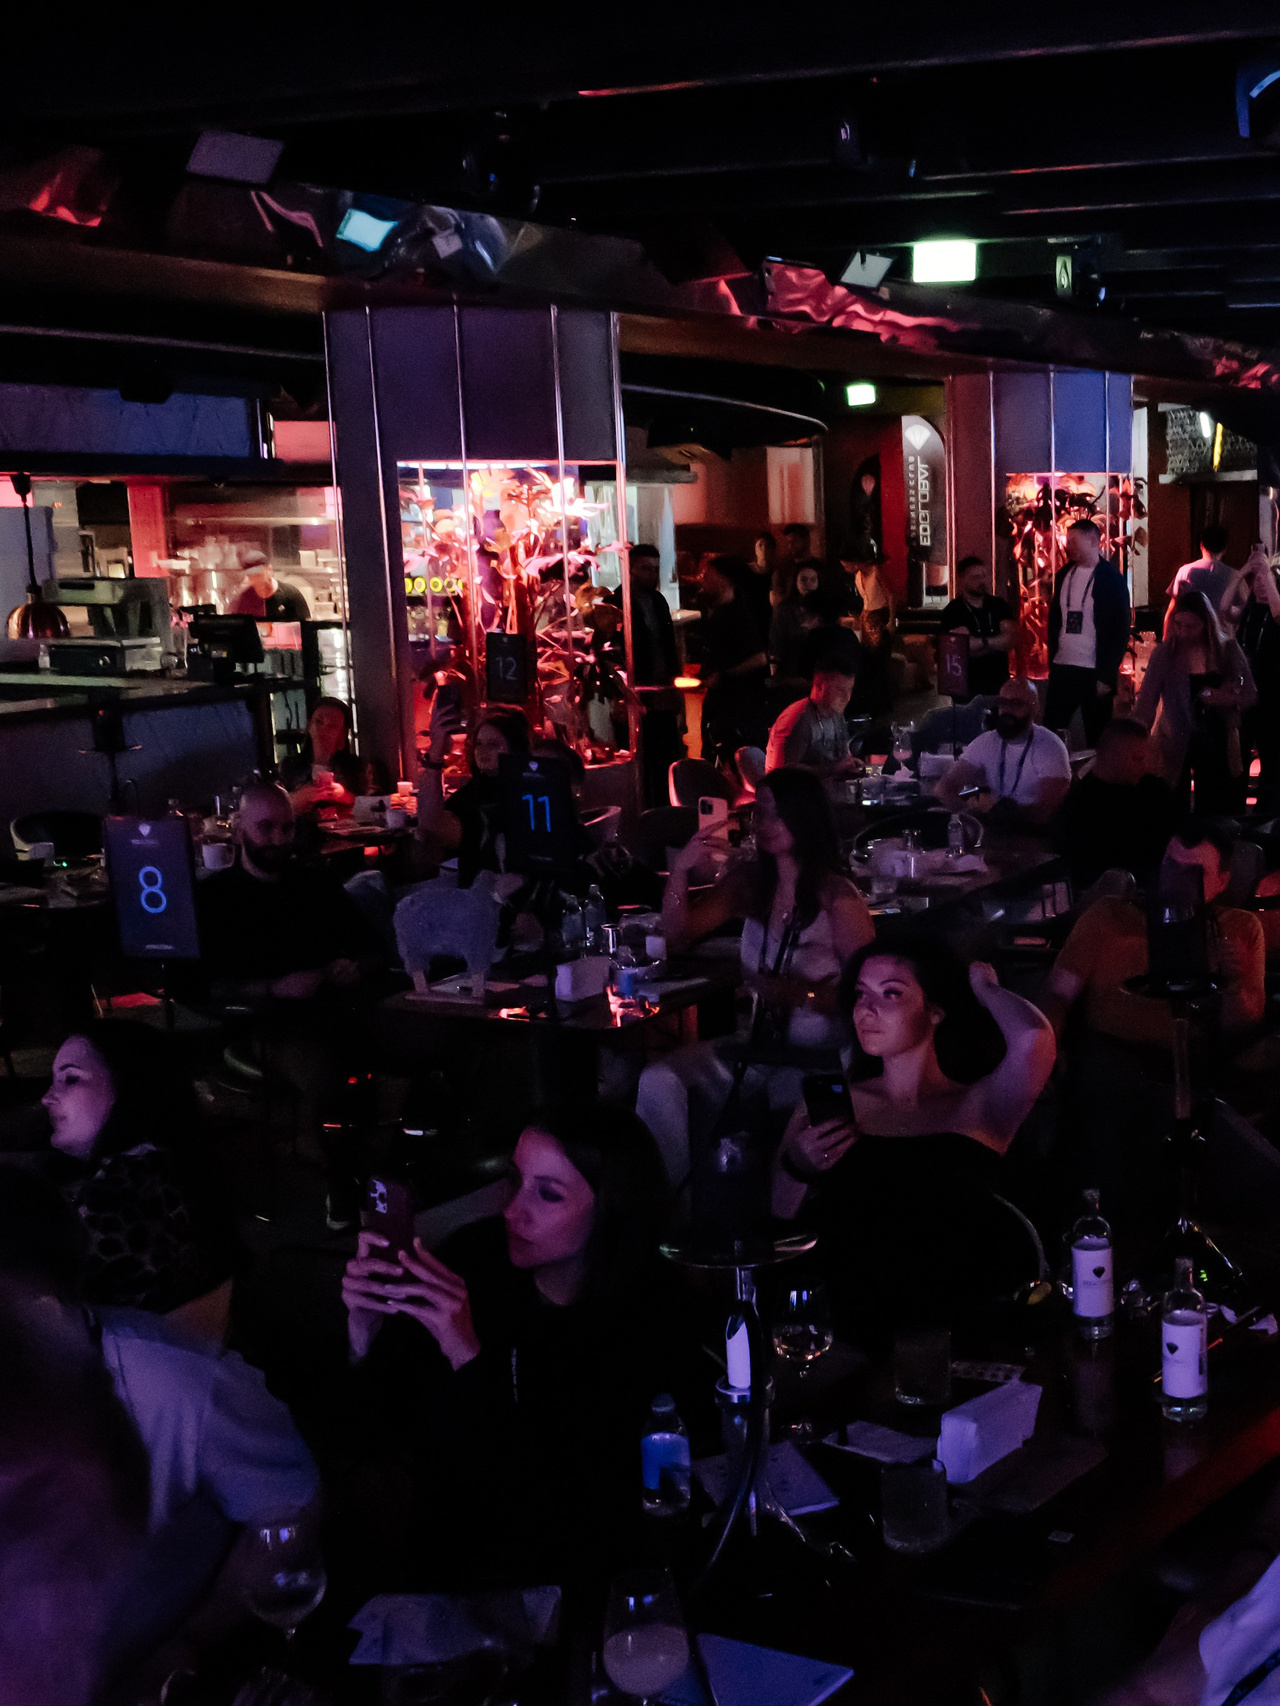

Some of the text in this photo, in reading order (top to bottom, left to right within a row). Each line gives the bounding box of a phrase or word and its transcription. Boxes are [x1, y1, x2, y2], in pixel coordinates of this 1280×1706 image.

[495, 656, 517, 681] 12
[945, 654, 962, 677] 15
[521, 793, 552, 834] 11
[138, 865, 167, 914] 8
